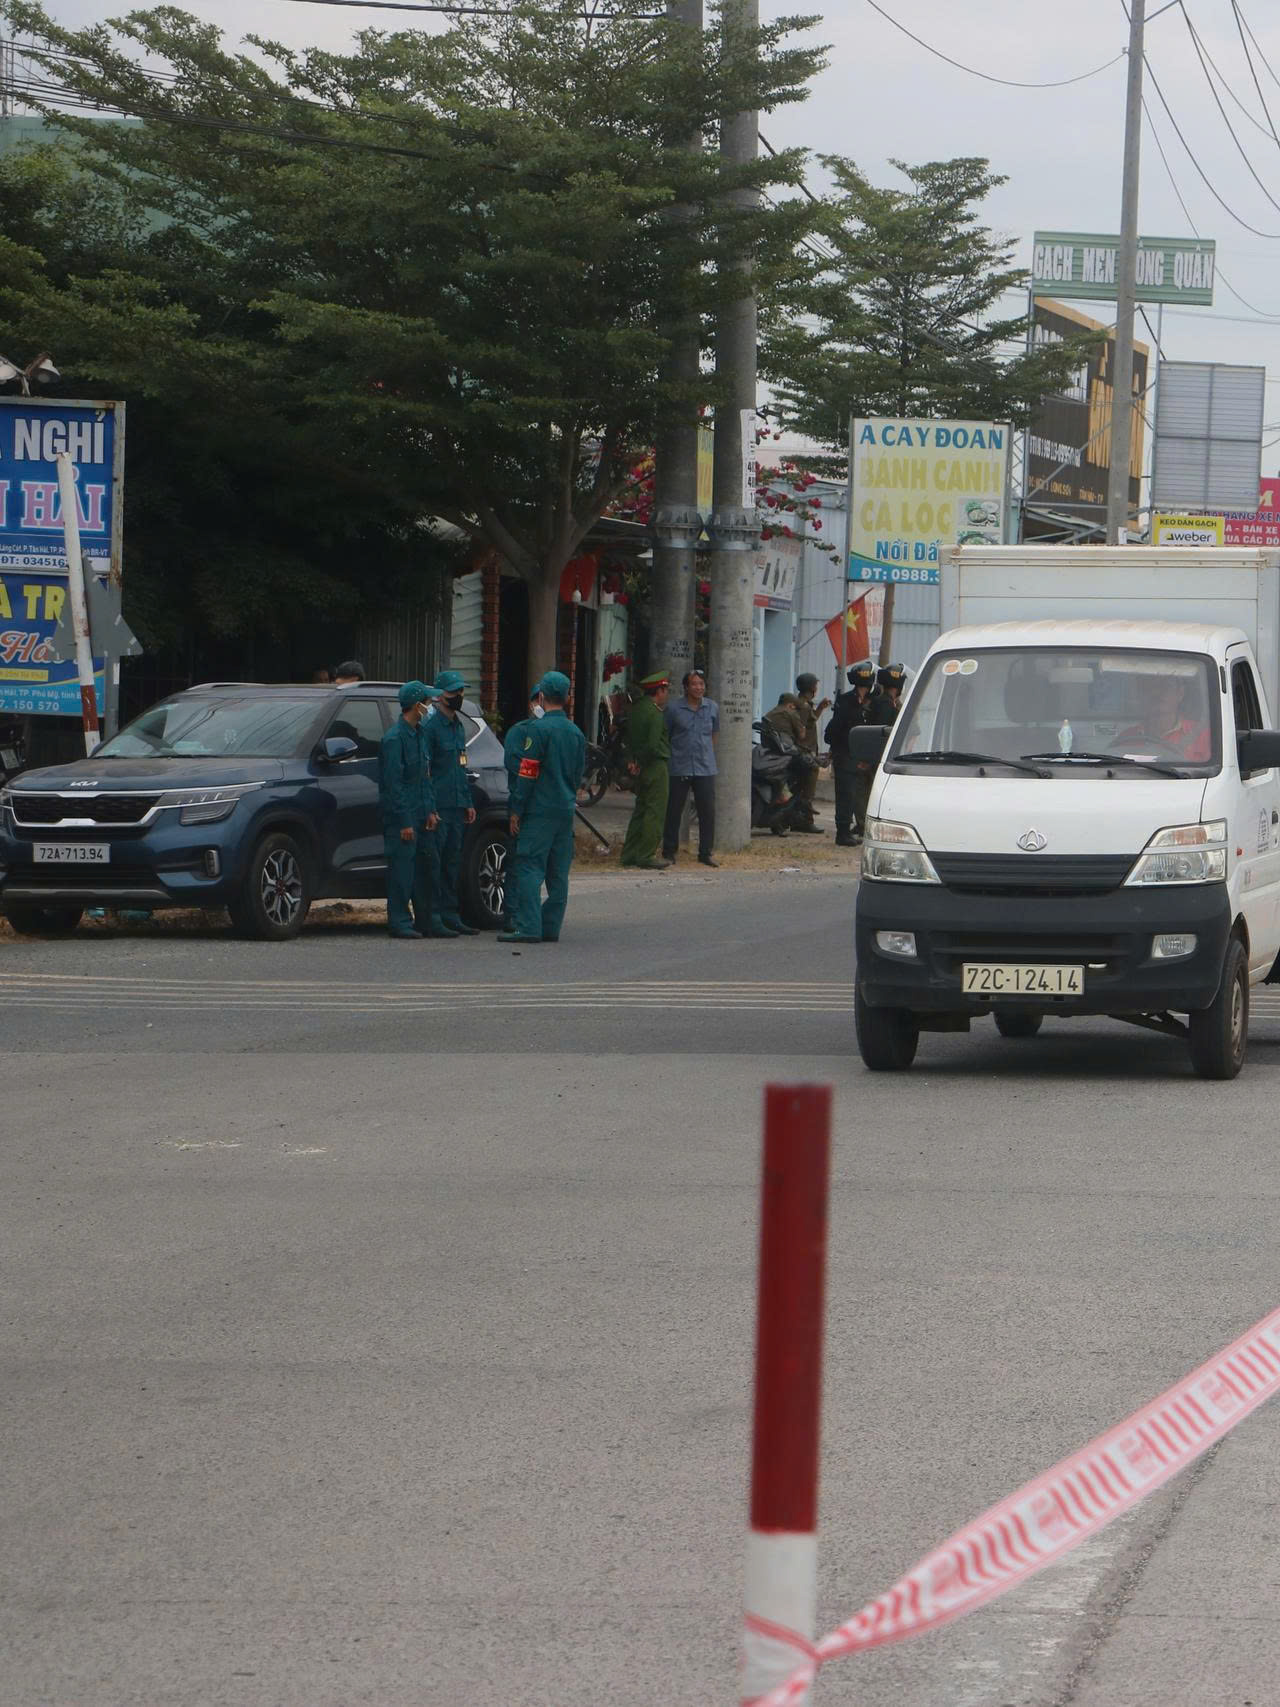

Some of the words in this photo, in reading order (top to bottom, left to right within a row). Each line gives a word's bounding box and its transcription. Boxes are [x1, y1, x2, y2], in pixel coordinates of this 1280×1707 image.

[1082, 247, 1116, 283] MEN
[14, 409, 104, 464] NGHỈ
[935, 427, 1002, 449] ĐOAN
[1259, 512, 1273, 522] XE
[1174, 531, 1212, 543] weber
[1265, 525, 1280, 535] XE
[914, 538, 940, 561] Đấ
[860, 568, 888, 580] ĐT:
[14, 700, 33, 710] 150
[38, 702, 60, 711] 570
[39, 847, 103, 861] 72A-713.94
[966, 967, 1079, 992] 72C-124.14
